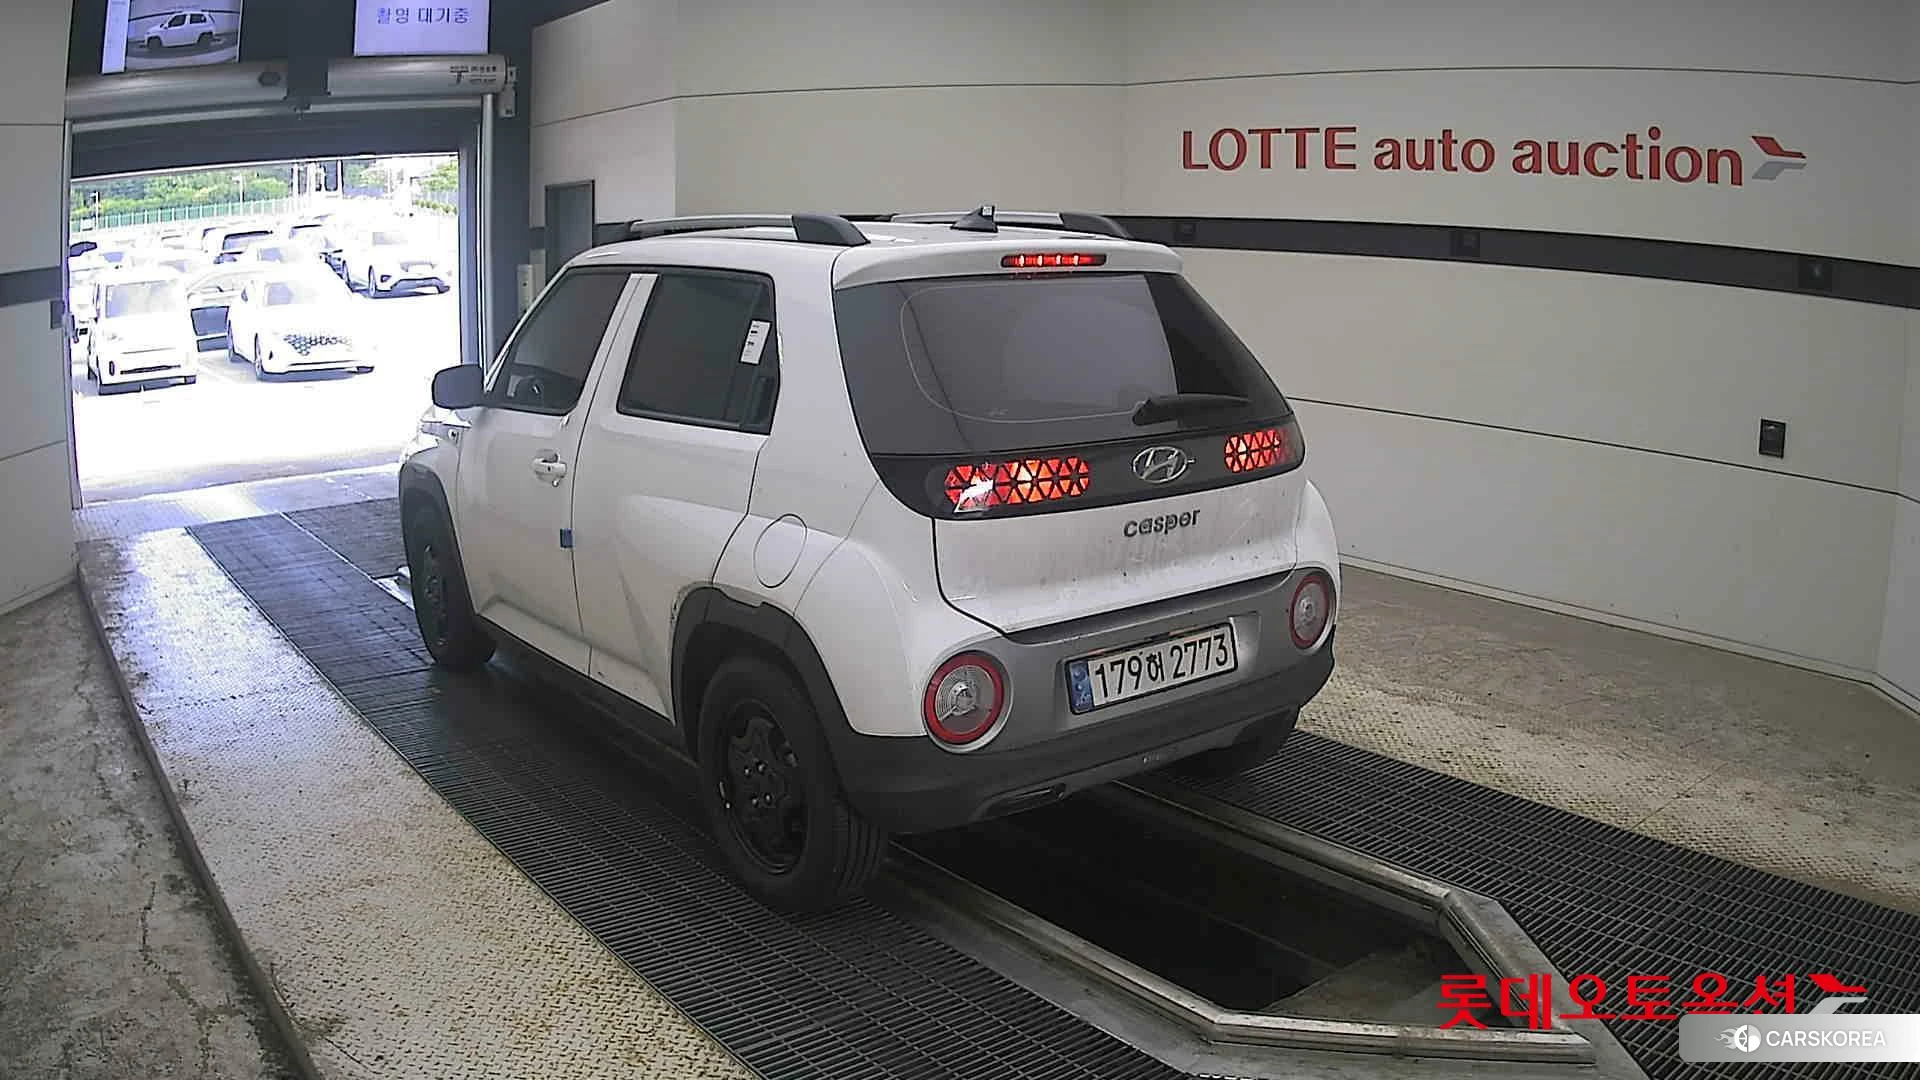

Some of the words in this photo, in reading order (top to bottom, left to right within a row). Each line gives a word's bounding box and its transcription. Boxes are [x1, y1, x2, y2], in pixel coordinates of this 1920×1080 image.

[418, 7, 469, 24] 대기중
[1182, 127, 1357, 171] LOTTE
[1373, 129, 1496, 172] auto
[1512, 126, 1743, 186] auction
[1123, 509, 1201, 537] casper
[1170, 634, 1228, 679] 2773
